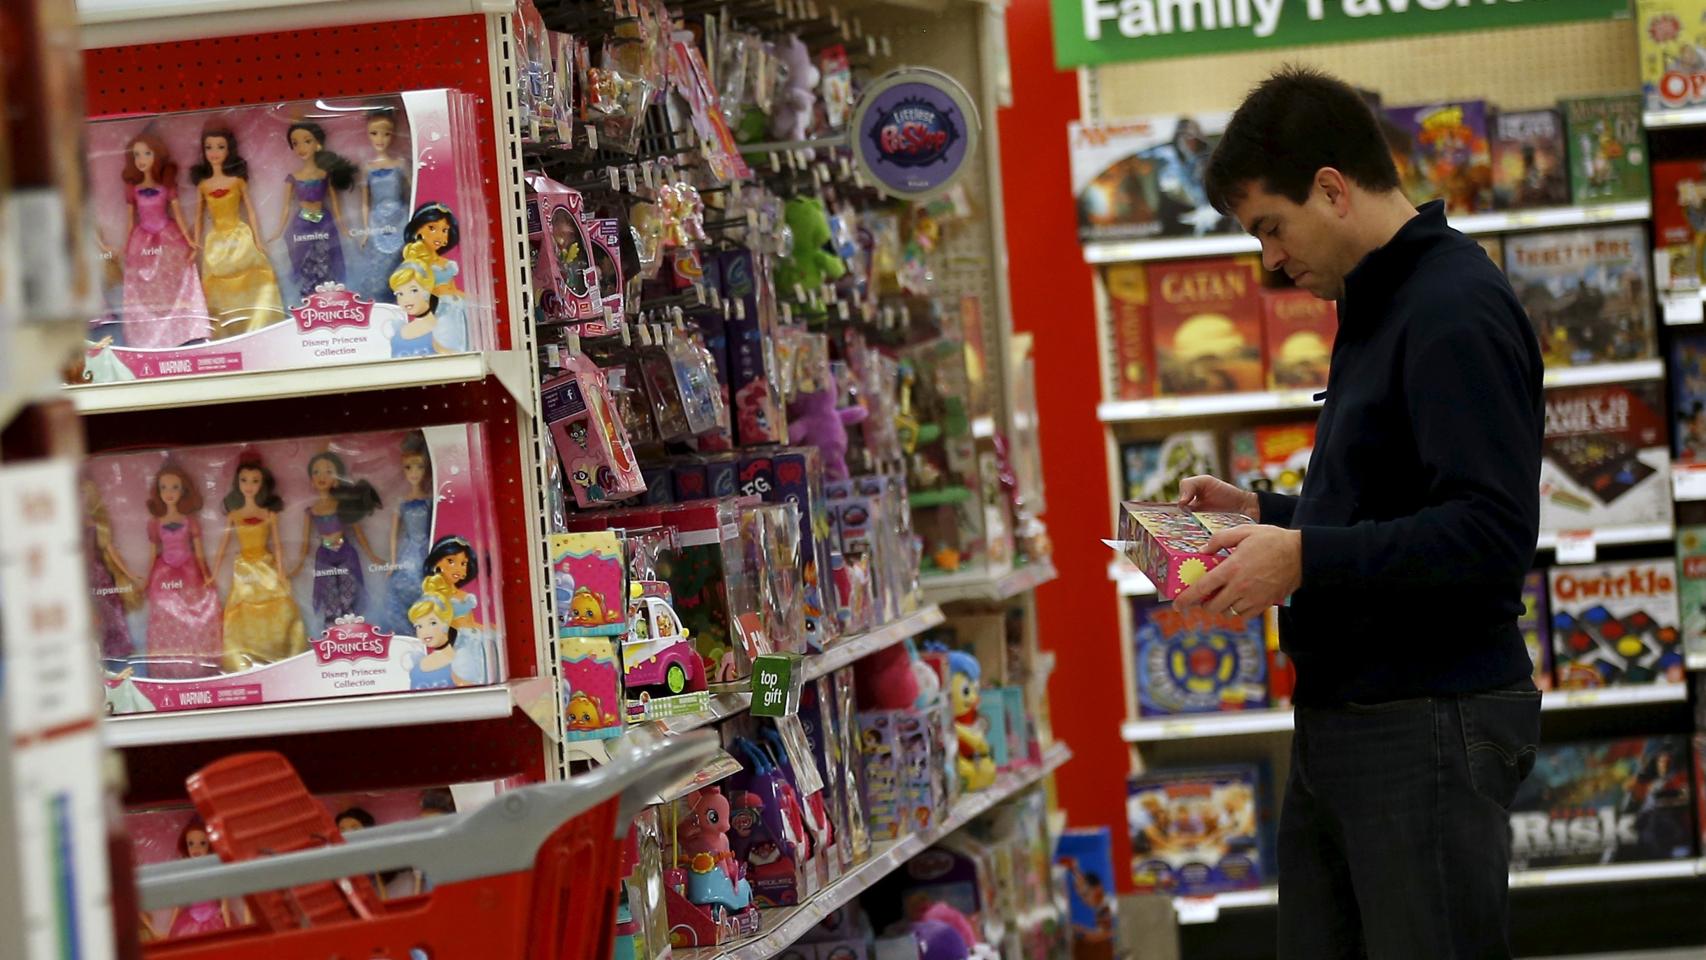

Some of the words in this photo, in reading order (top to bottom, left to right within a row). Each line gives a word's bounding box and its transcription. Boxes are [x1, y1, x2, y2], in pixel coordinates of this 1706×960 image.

[1083, 0, 1284, 41] Family
[141, 246, 163, 256] Ariel
[1161, 269, 1247, 303] CATAN
[161, 580, 183, 590] Ariel
[760, 670, 778, 687] top
[764, 690, 783, 707] gift
